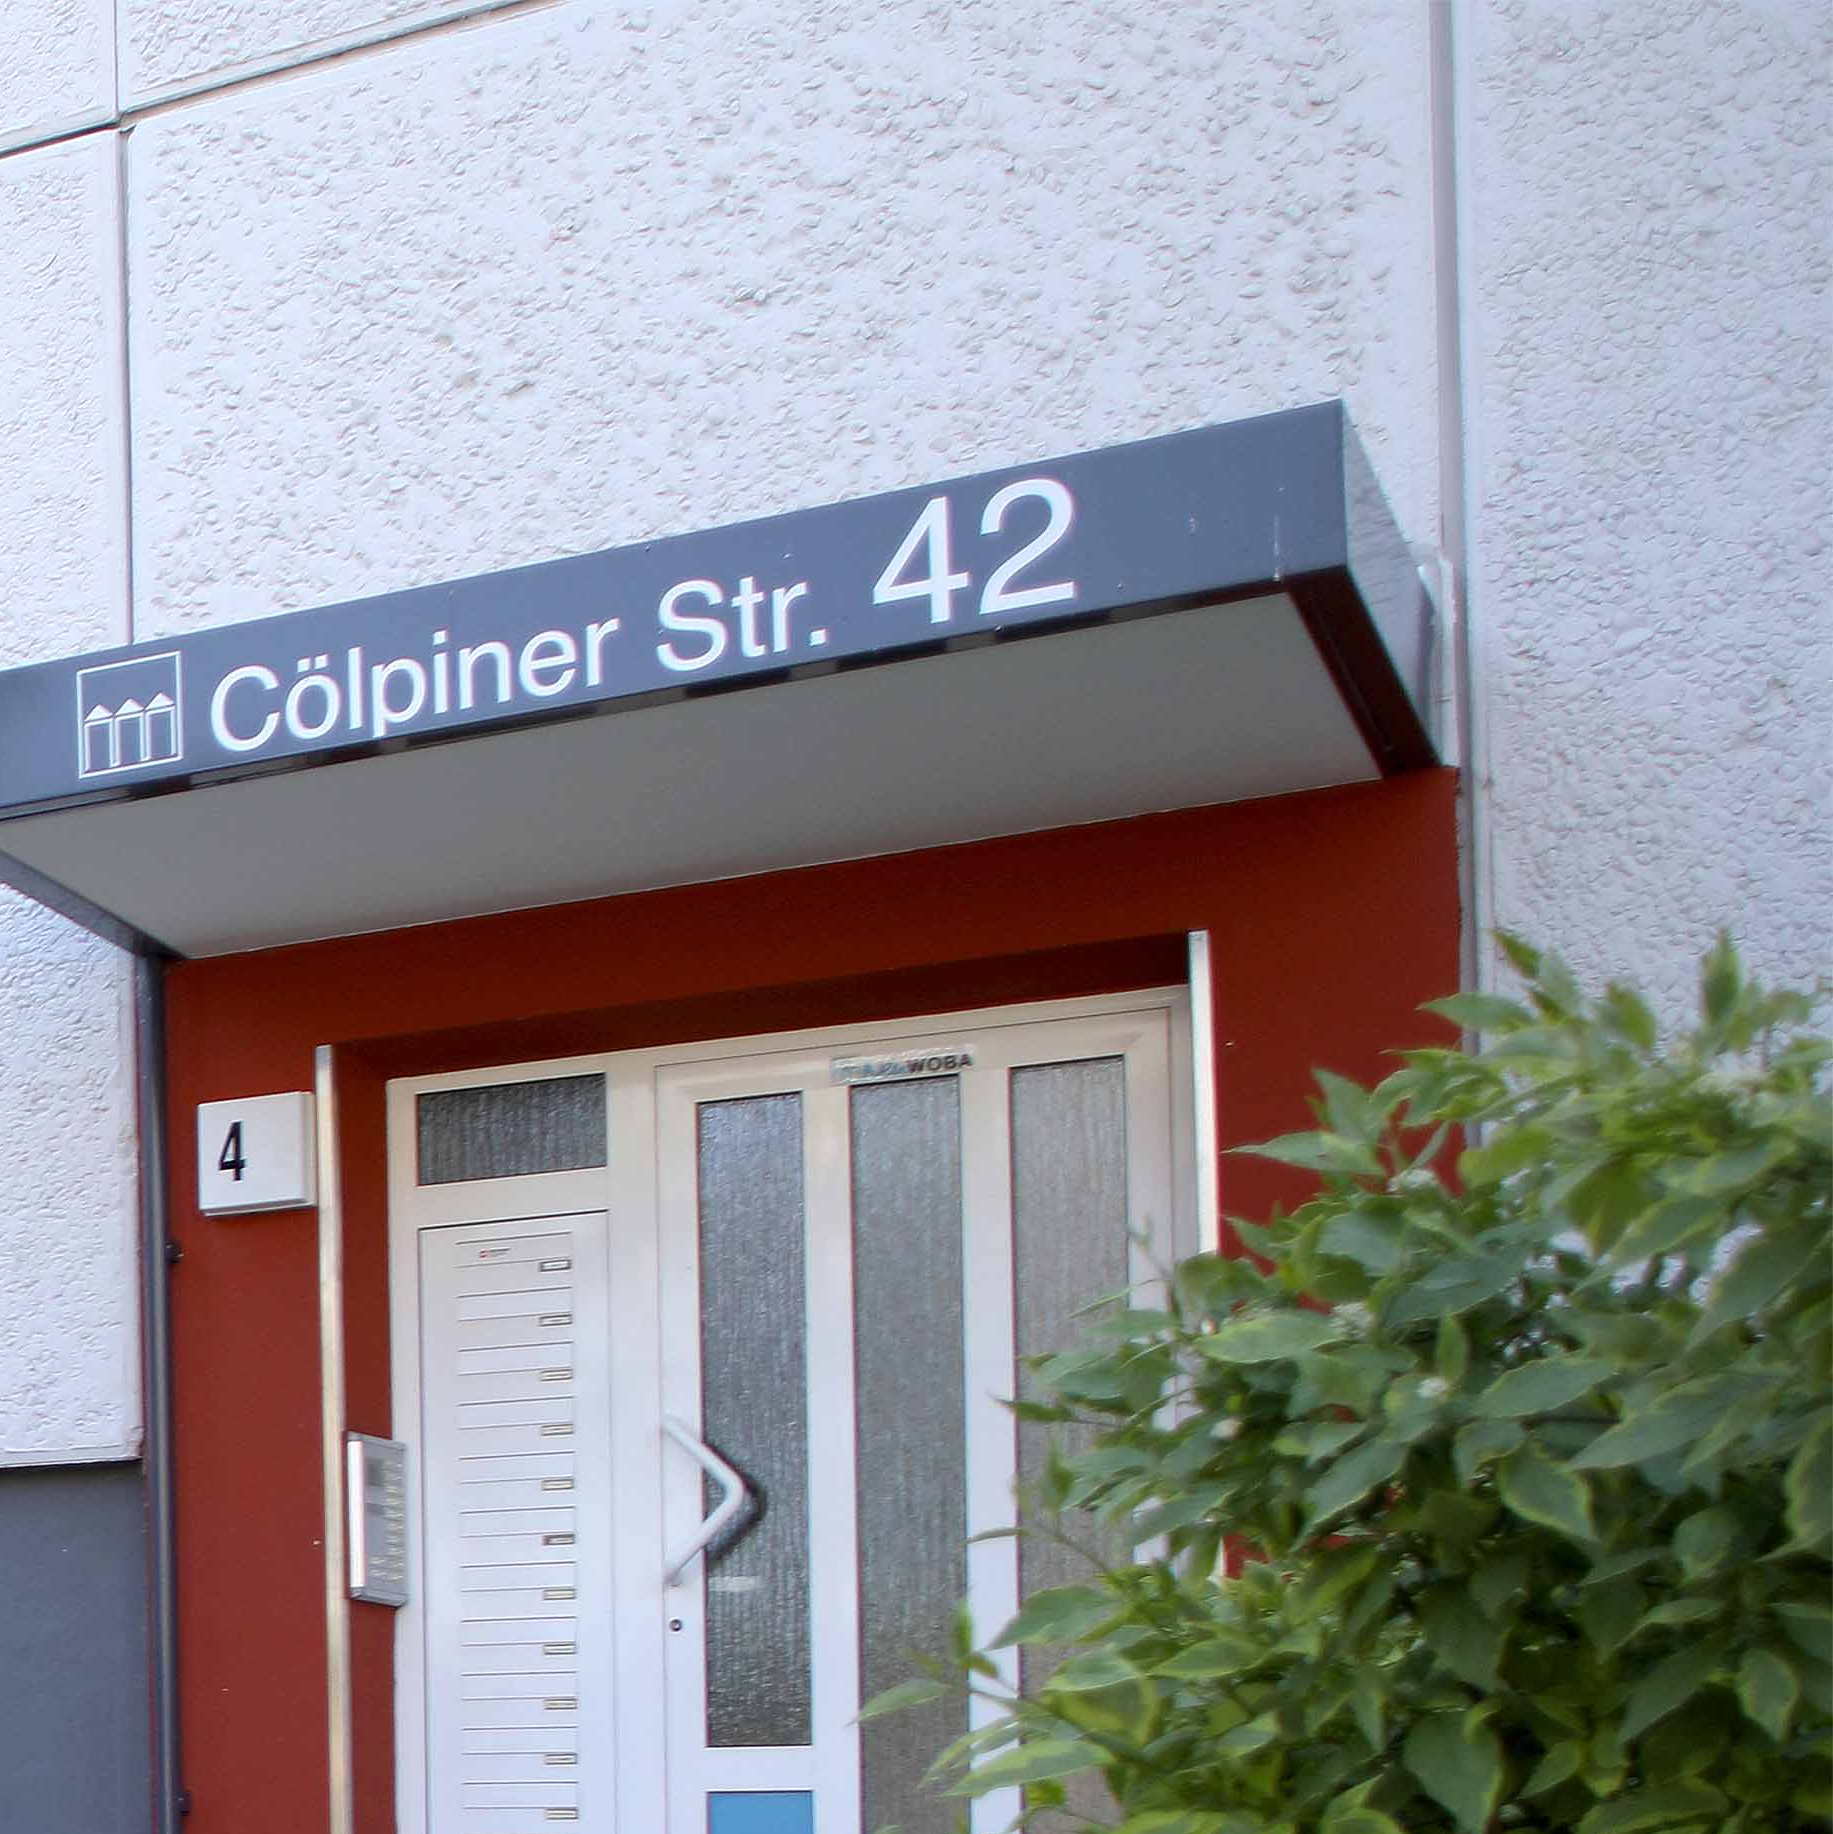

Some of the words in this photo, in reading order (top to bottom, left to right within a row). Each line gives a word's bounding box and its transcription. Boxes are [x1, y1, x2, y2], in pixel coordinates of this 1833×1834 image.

[209, 614, 621, 754] Cölpiner
[655, 574, 827, 673] Str.
[871, 475, 1077, 625] 42
[219, 1120, 246, 1182] 4
